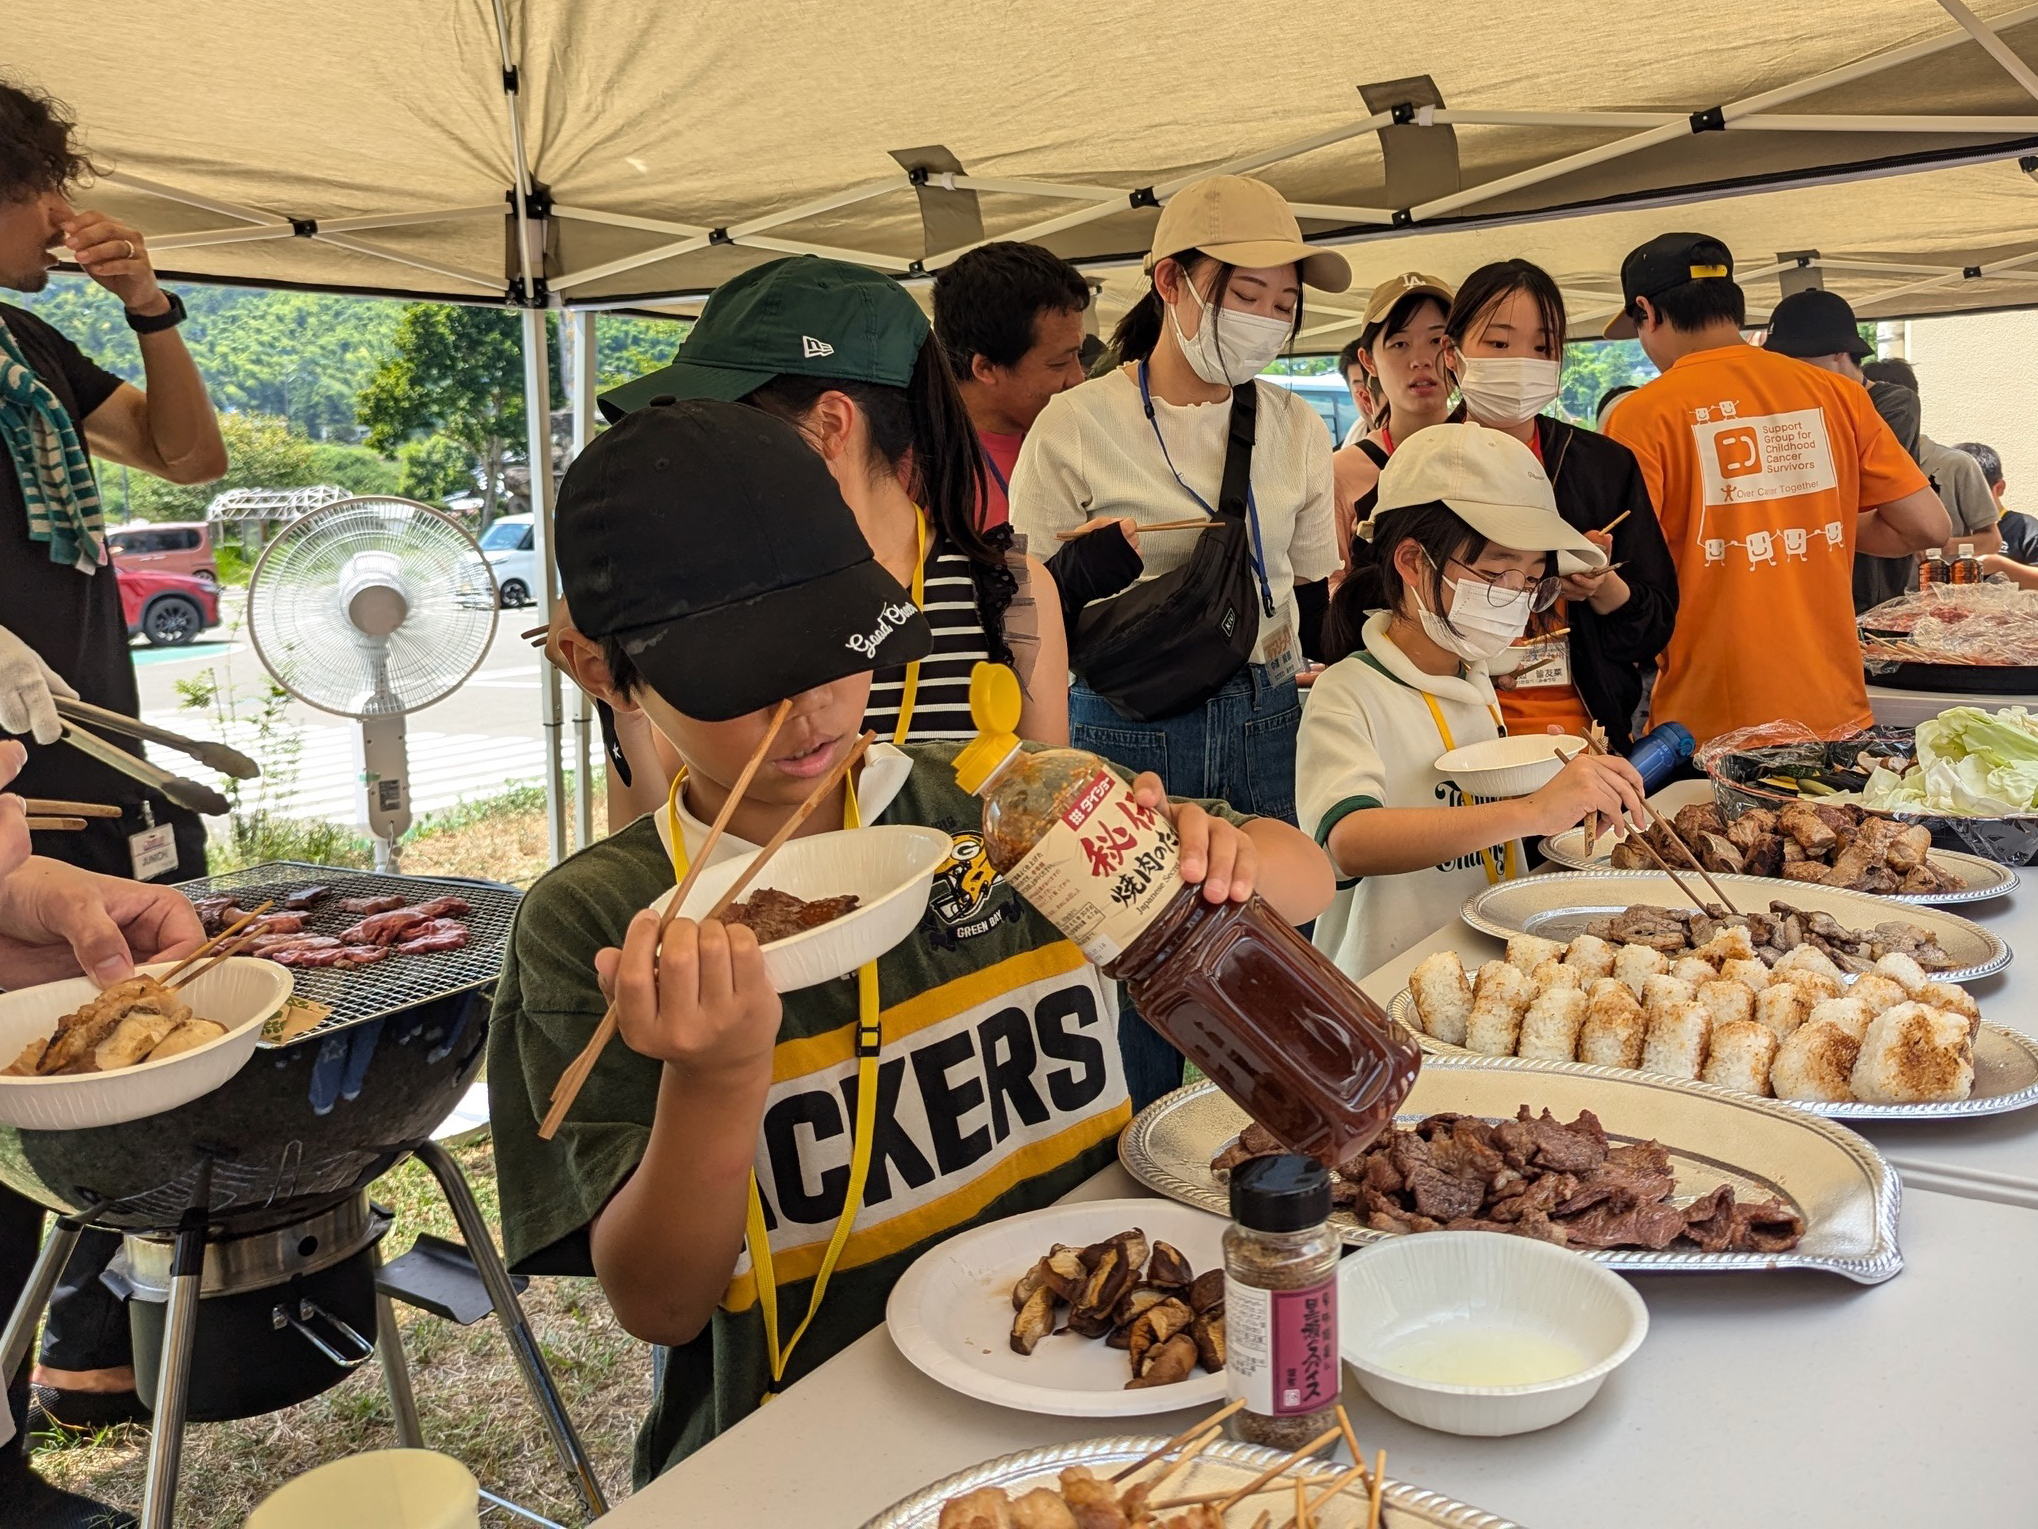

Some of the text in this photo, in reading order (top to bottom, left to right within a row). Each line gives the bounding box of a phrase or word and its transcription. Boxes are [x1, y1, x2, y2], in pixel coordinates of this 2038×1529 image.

[1400, 273, 1426, 290] LA
[1762, 422, 1802, 434] Support
[1764, 430, 1812, 444] Group for
[1765, 441, 1816, 453] Childhood
[1766, 452, 1802, 464] Cancer
[1767, 461, 1815, 473] Survivors
[1779, 480, 1819, 493] Together
[1080, 777, 1112, 815] ダイショー
[1136, 883, 1165, 916] Japanese
[957, 909, 1004, 938] GREEN BAY
[755, 983, 1108, 1233] CKERS
